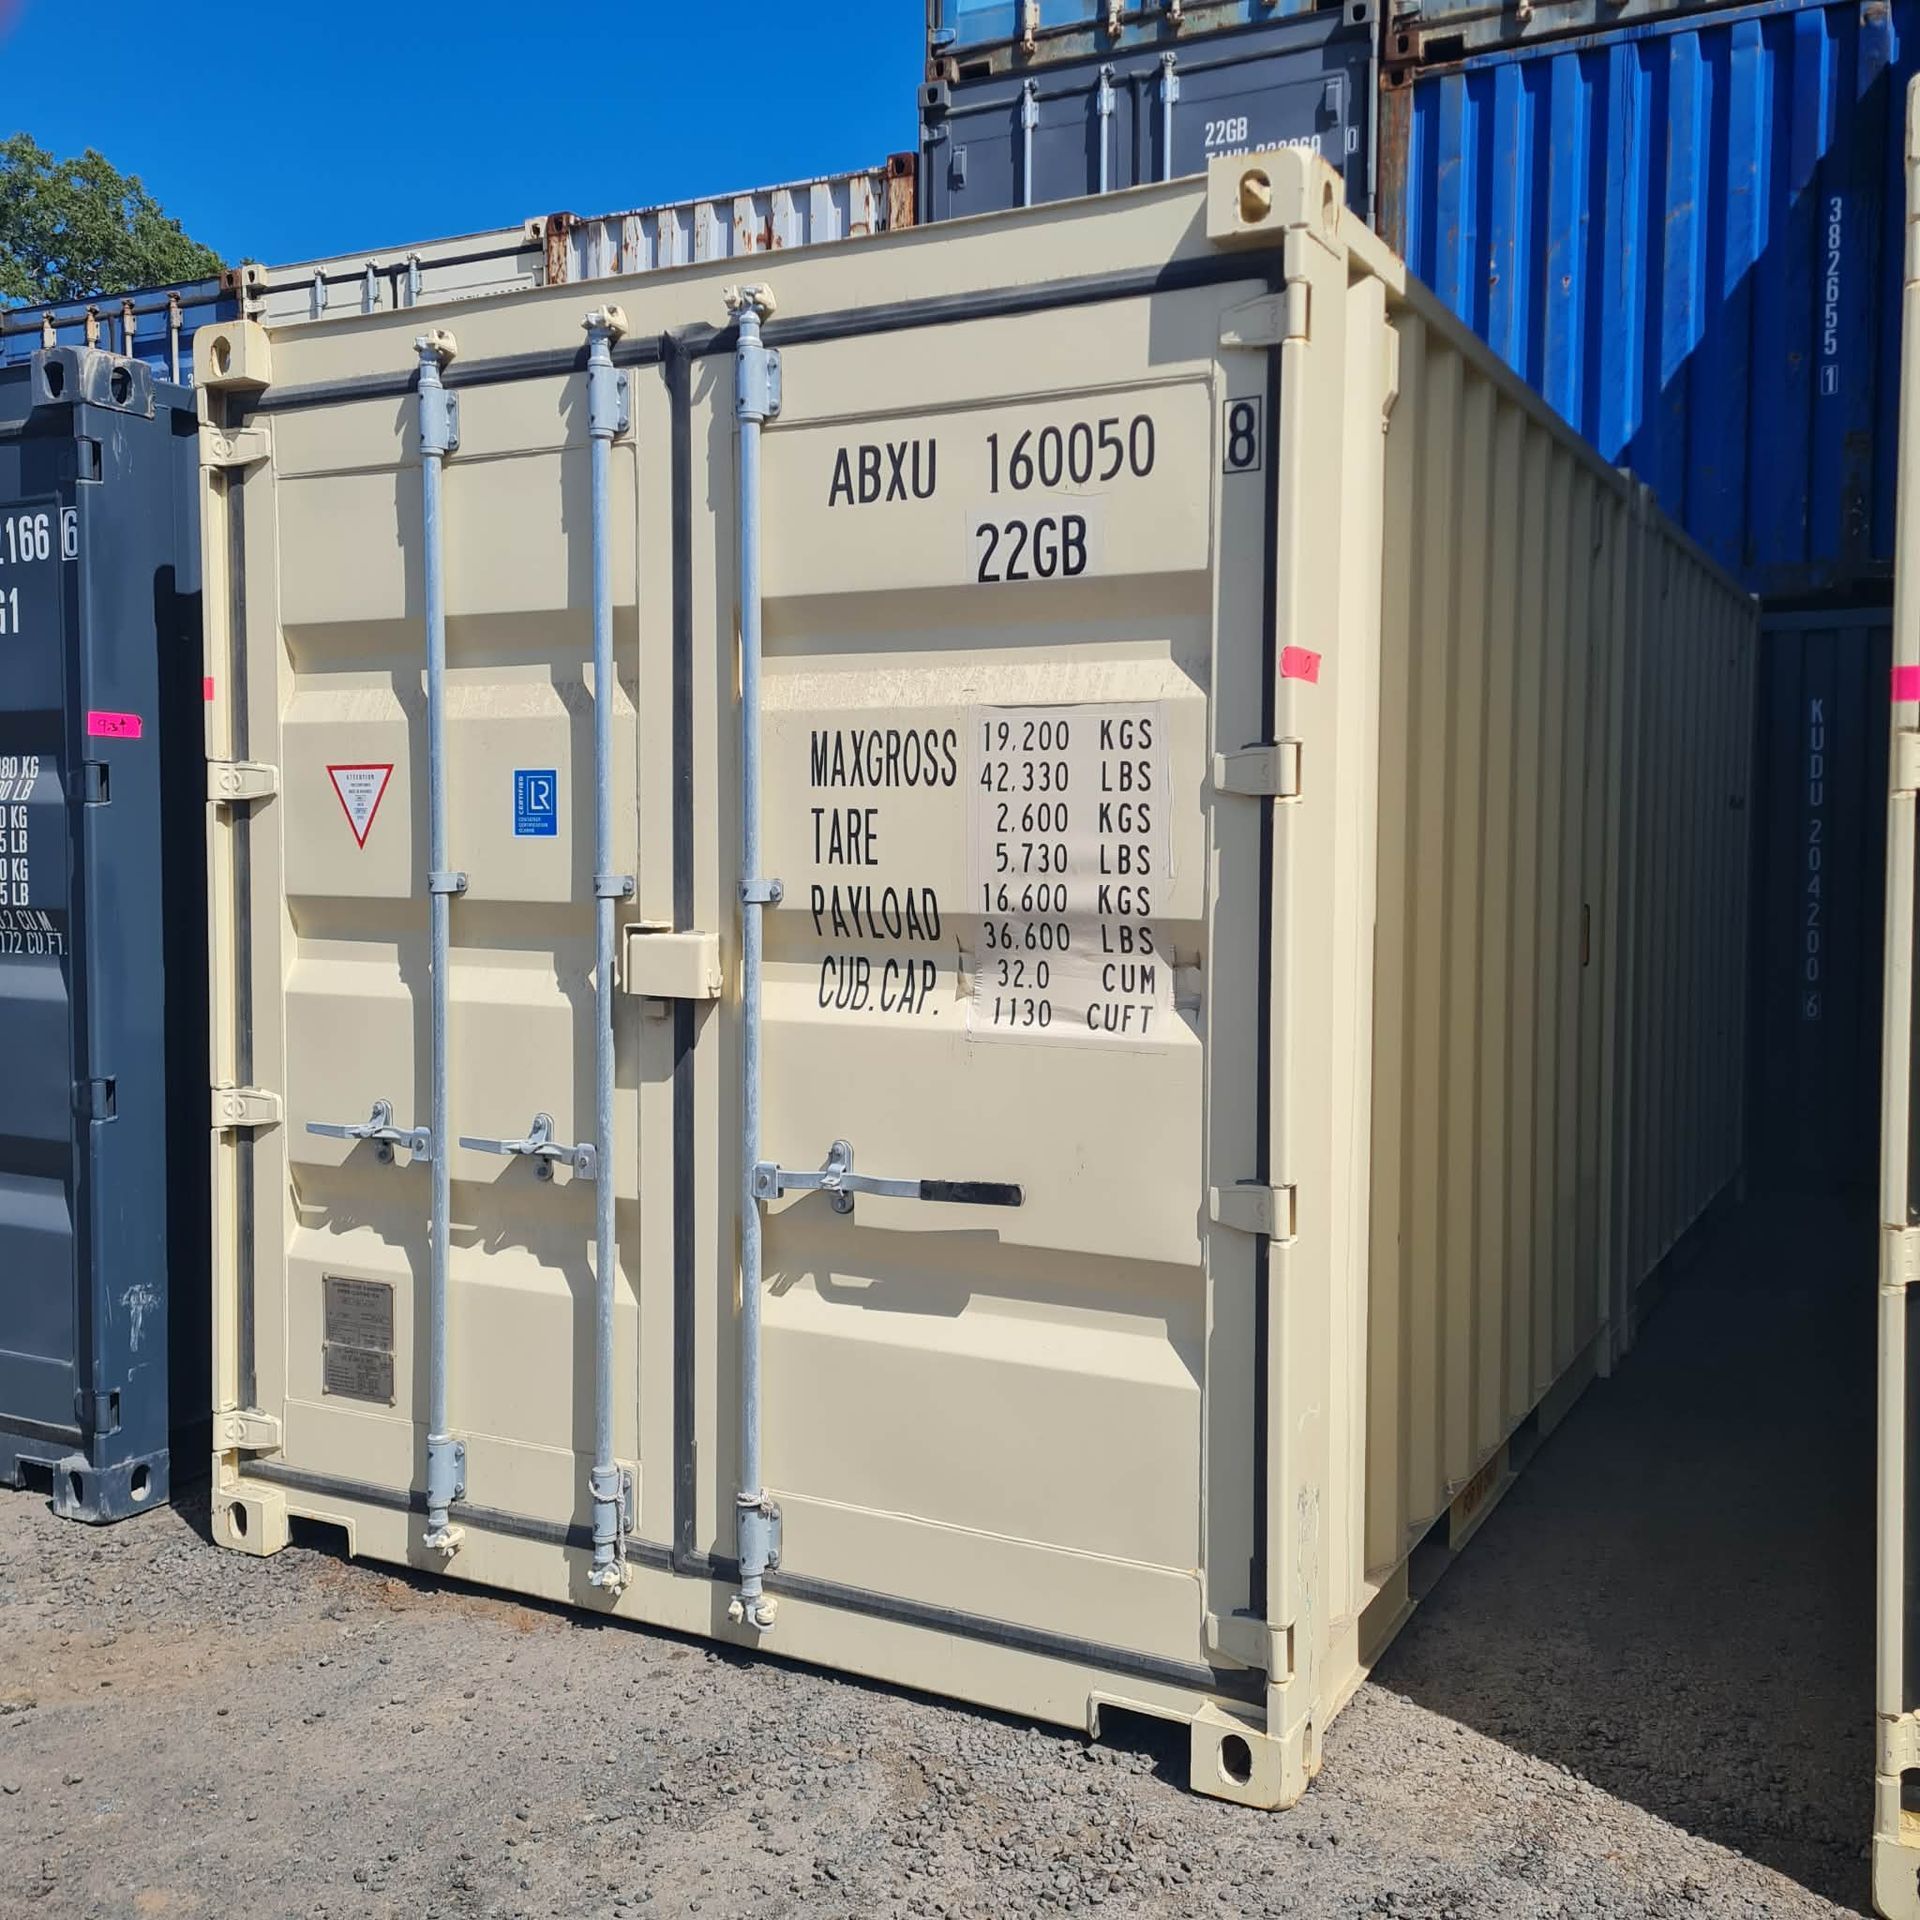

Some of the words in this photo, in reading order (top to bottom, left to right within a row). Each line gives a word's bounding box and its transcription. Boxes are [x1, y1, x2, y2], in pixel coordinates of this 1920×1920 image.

[1205, 117, 1247, 146] 22GB
[1824, 197, 1842, 354] 382655
[1825, 367, 1834, 391] 1
[828, 438, 936, 507] ABXU
[986, 414, 1155, 494] 160050
[1228, 402, 1255, 467] 8
[0, 514, 49, 564] 166
[63, 509, 78, 556] 6
[975, 514, 1087, 583] 22GB
[21, 755, 39, 779] KG
[811, 728, 957, 787] MAXGROSS
[984, 721, 1069, 752] 19,200
[1100, 719, 1152, 751] KGS
[1811, 699, 1824, 806] KUDU
[12, 779, 35, 801] LB
[980, 761, 1068, 792] 42,330
[1101, 761, 1152, 792] LBS
[531, 781, 550, 810] LR
[11, 805, 27, 829] KG
[11, 830, 28, 853] LB
[811, 808, 878, 865] TARE
[997, 803, 1068, 832] 2,600
[1099, 802, 1151, 833] KGS
[12, 858, 28, 881] KG
[996, 843, 1067, 873] 5,730
[1100, 844, 1151, 875] LBS
[12, 882, 29, 905] LB
[1807, 819, 1822, 982] 204200
[811, 884, 941, 941] PAYLOAD
[1098, 884, 1150, 916] KGS
[984, 922, 1070, 951] 36,600
[1101, 923, 1154, 954] LBS
[818, 955, 939, 1015] CUB.CAP.
[997, 959, 1050, 989] 32.0
[1102, 963, 1155, 994] CUM
[994, 997, 1051, 1027] 1130
[1086, 1003, 1154, 1034] CUFT
